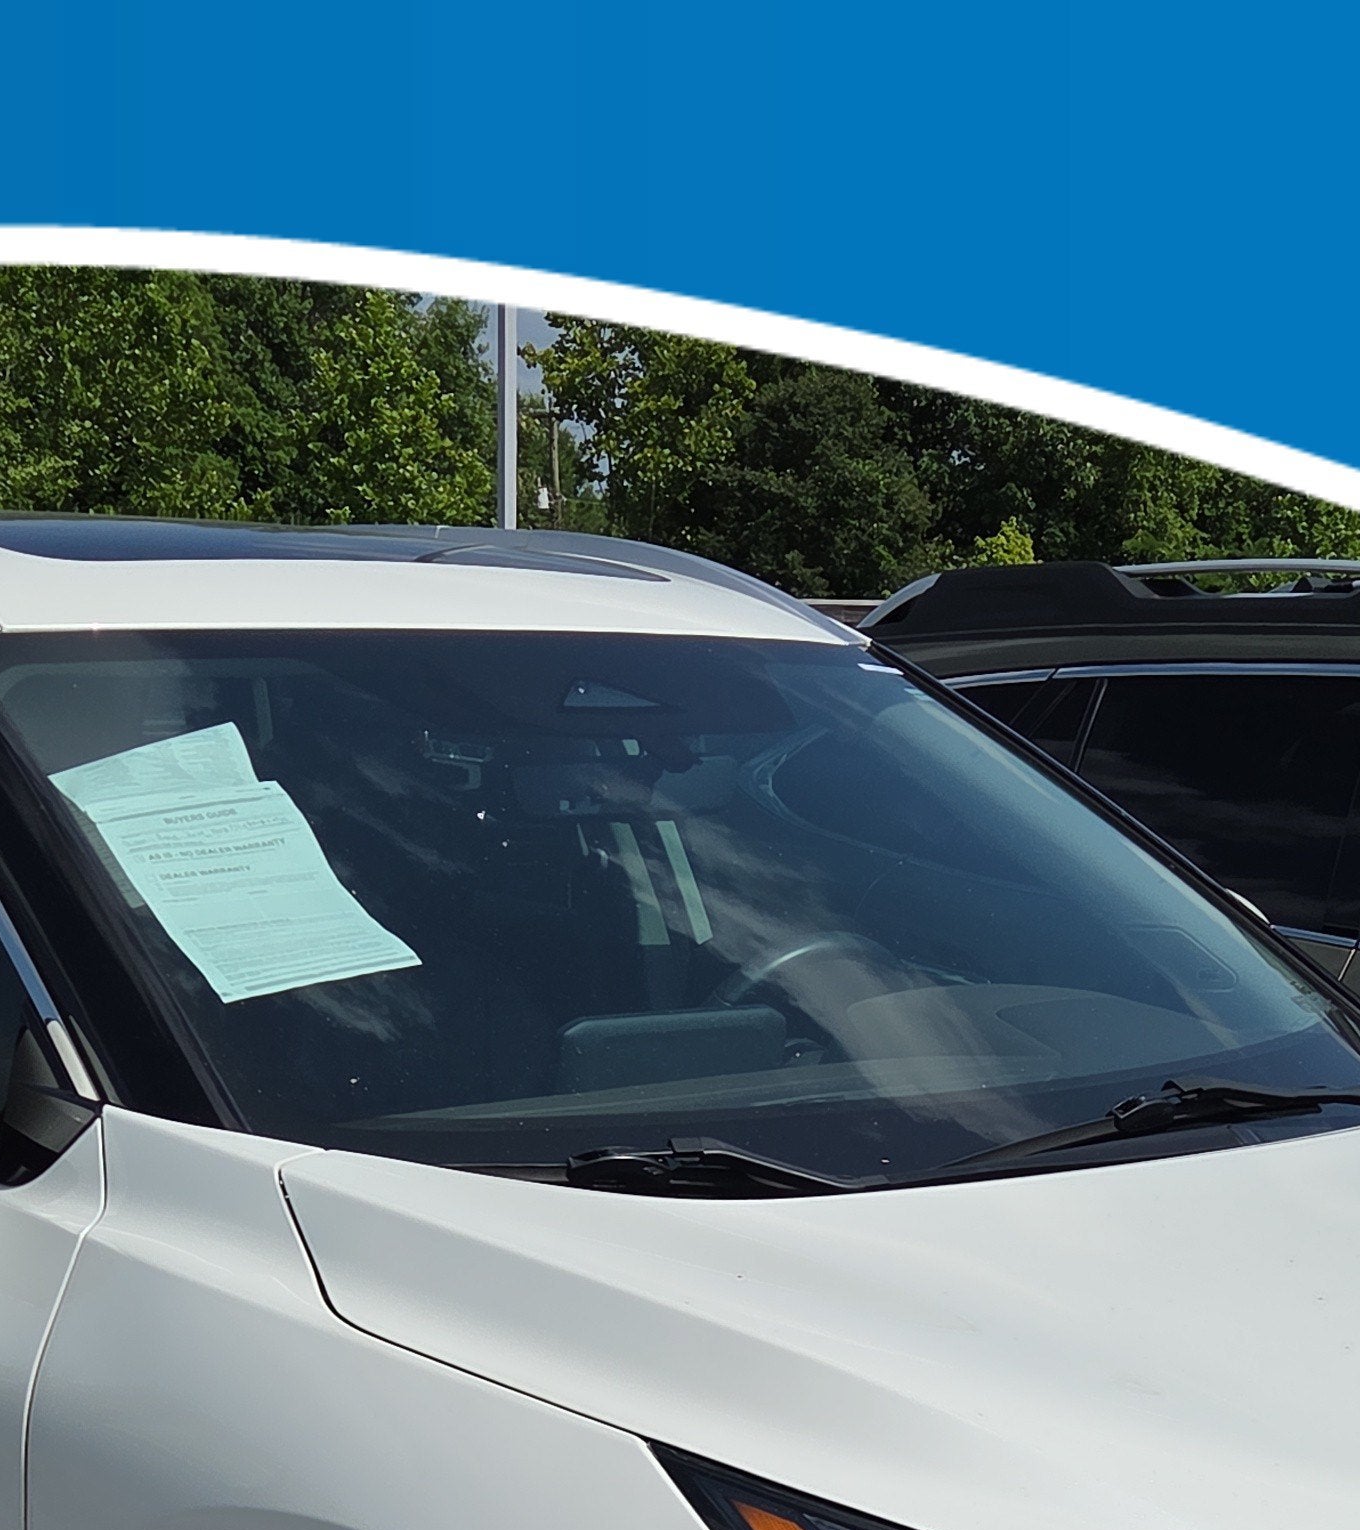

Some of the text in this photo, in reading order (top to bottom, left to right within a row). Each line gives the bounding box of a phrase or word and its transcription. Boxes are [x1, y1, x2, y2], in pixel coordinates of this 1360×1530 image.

[194, 846, 231, 856] DEALER
[233, 837, 285, 852] WARRANTY
[158, 865, 251, 881] DEALER WARRANTY
